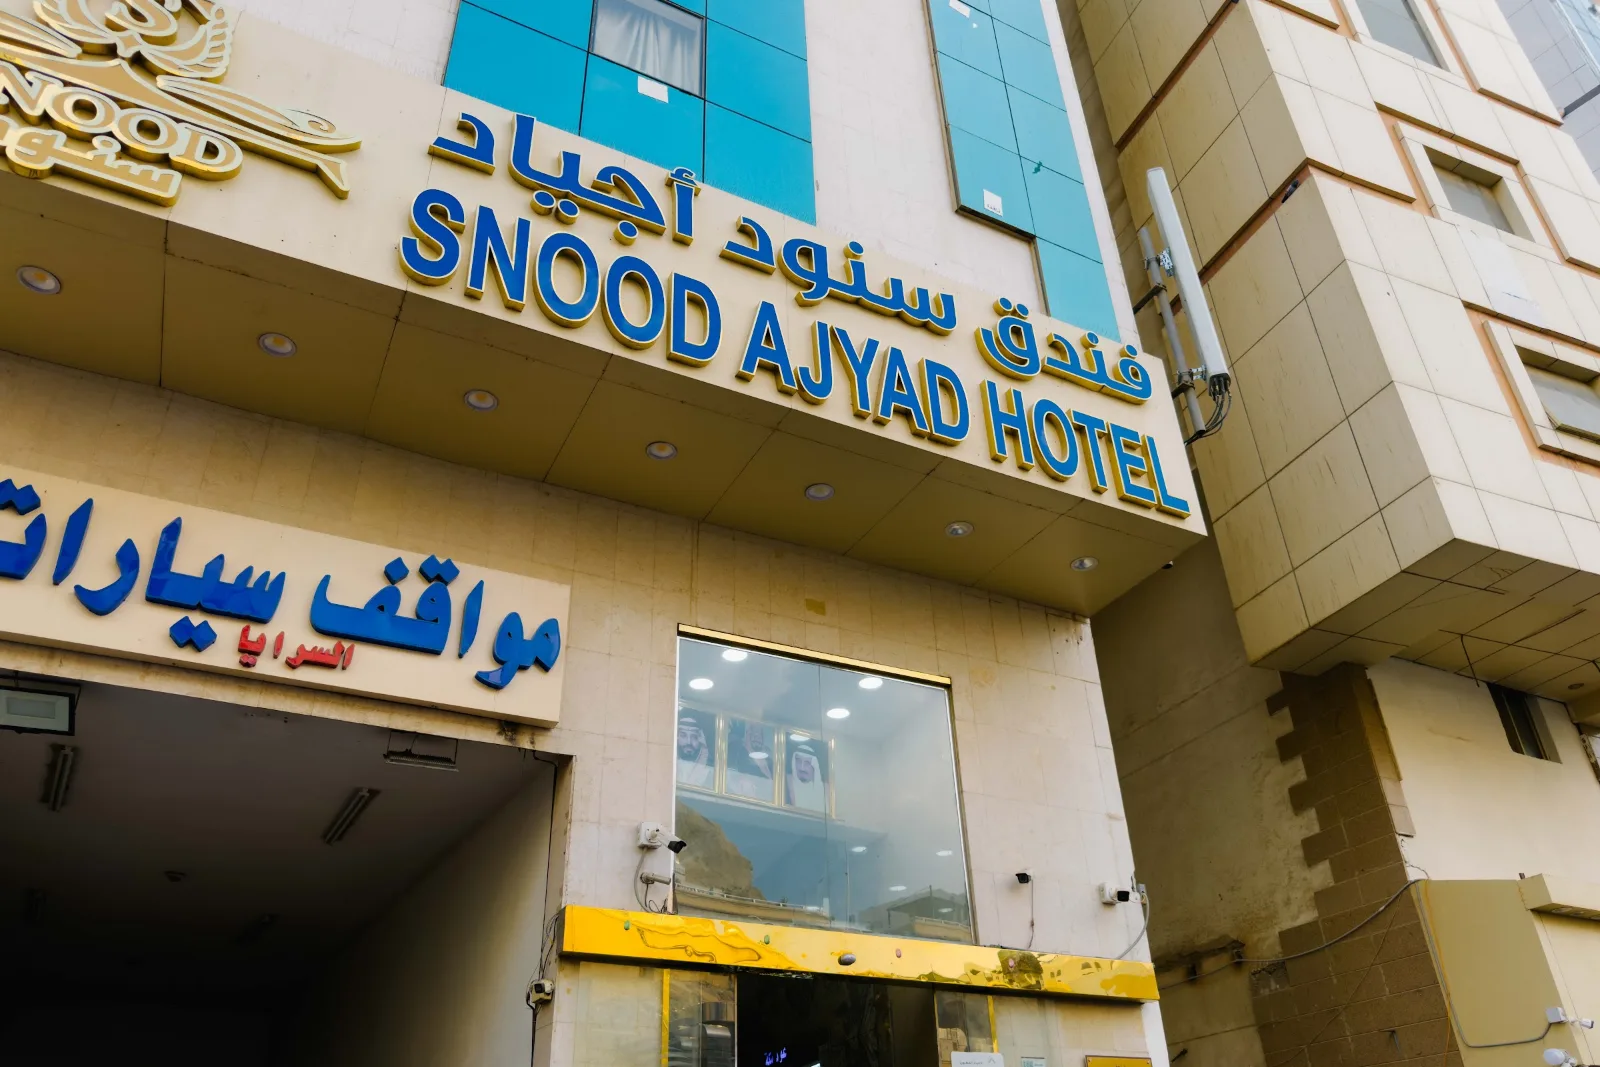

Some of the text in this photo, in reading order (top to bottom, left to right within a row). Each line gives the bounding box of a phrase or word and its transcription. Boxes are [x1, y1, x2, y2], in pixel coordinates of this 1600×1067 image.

[400, 188, 1191, 519] SNOOD AJYAD HOTEL
[428, 112, 1152, 404] فندق سنود أجياد
[238, 624, 355, 671] السرايا
[310, 554, 560, 690] مواقف
